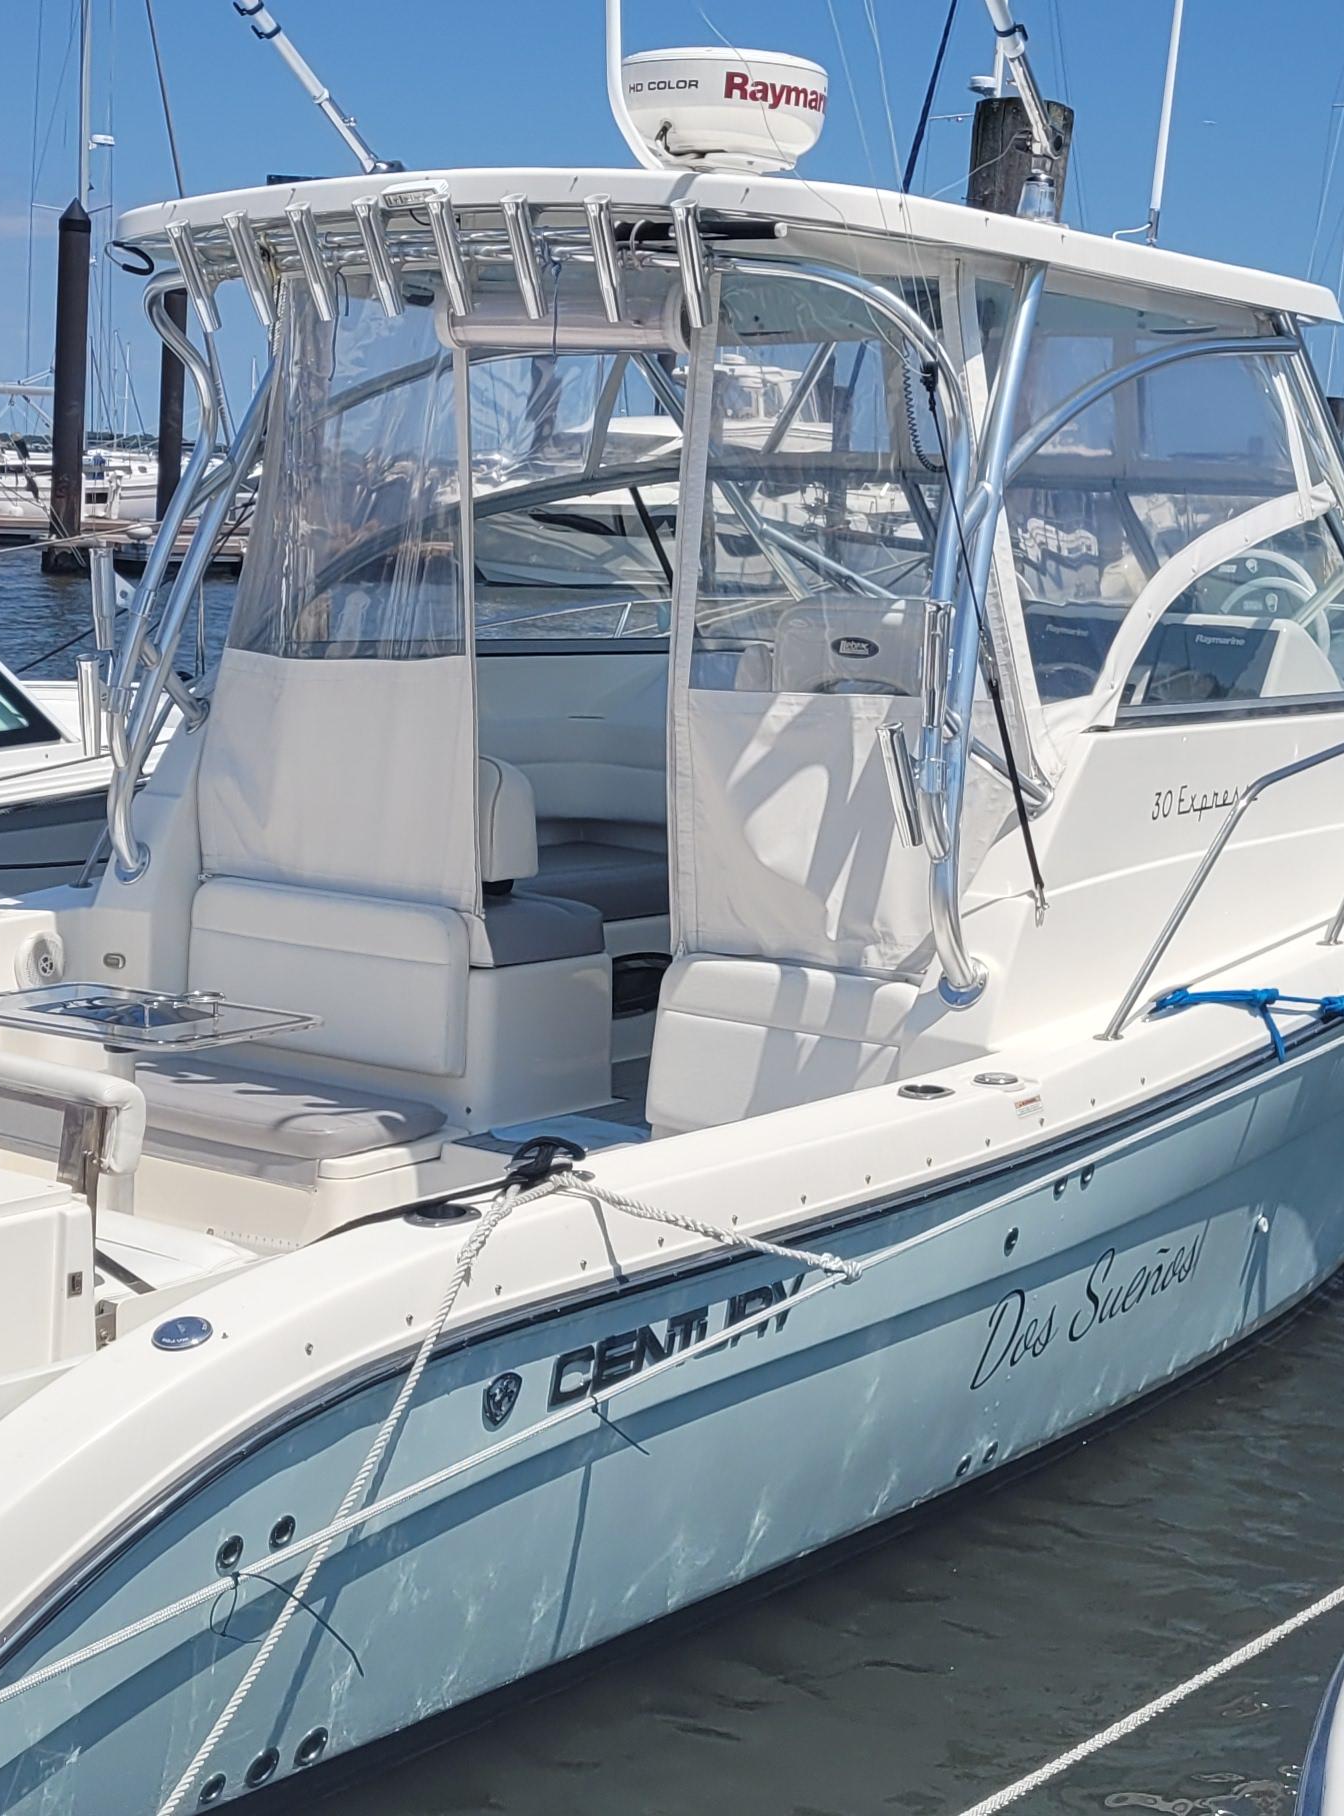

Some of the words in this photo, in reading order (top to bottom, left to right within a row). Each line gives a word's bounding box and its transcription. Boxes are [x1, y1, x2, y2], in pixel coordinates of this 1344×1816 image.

[629, 83, 644, 94] HD
[647, 79, 700, 92] COLOR
[1194, 633, 1246, 647] Raymarine
[1151, 788, 1173, 821] 30
[1177, 784, 1258, 822] Expres
[969, 1288, 1057, 1391] Dos
[1068, 1233, 1201, 1343] Sueños
